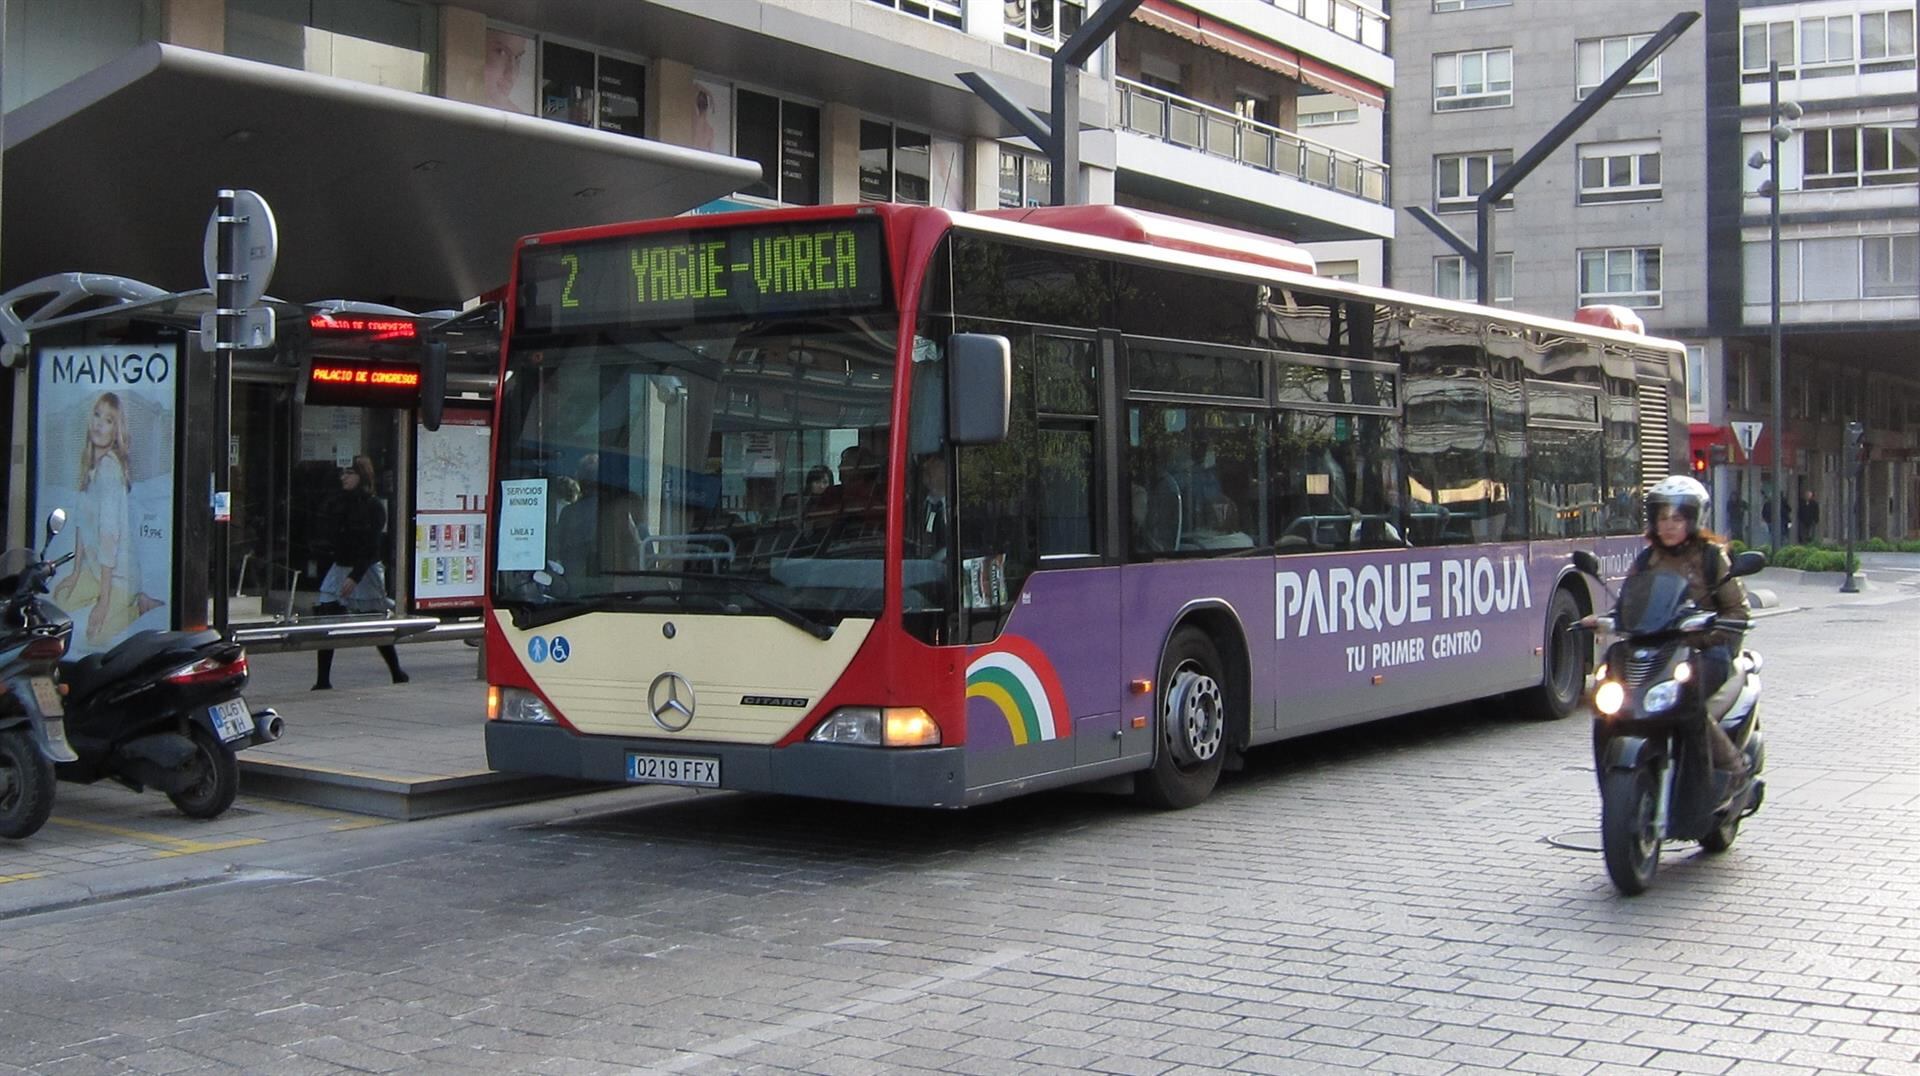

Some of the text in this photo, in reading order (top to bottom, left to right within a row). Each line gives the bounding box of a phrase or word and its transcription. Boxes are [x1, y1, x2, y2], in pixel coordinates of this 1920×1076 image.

[561, 255, 579, 308] 2
[52, 353, 169, 384] MANGO
[313, 369, 353, 381] PALACIO
[355, 371, 368, 382] DE
[506, 487, 543, 496] SERVICIOS
[1276, 554, 1532, 640] PARQUE RIOJA
[1346, 629, 1482, 673] TU PRIMER CENTRO
[743, 697, 806, 706] CITARO
[637, 758, 715, 782] 0219 FFX
